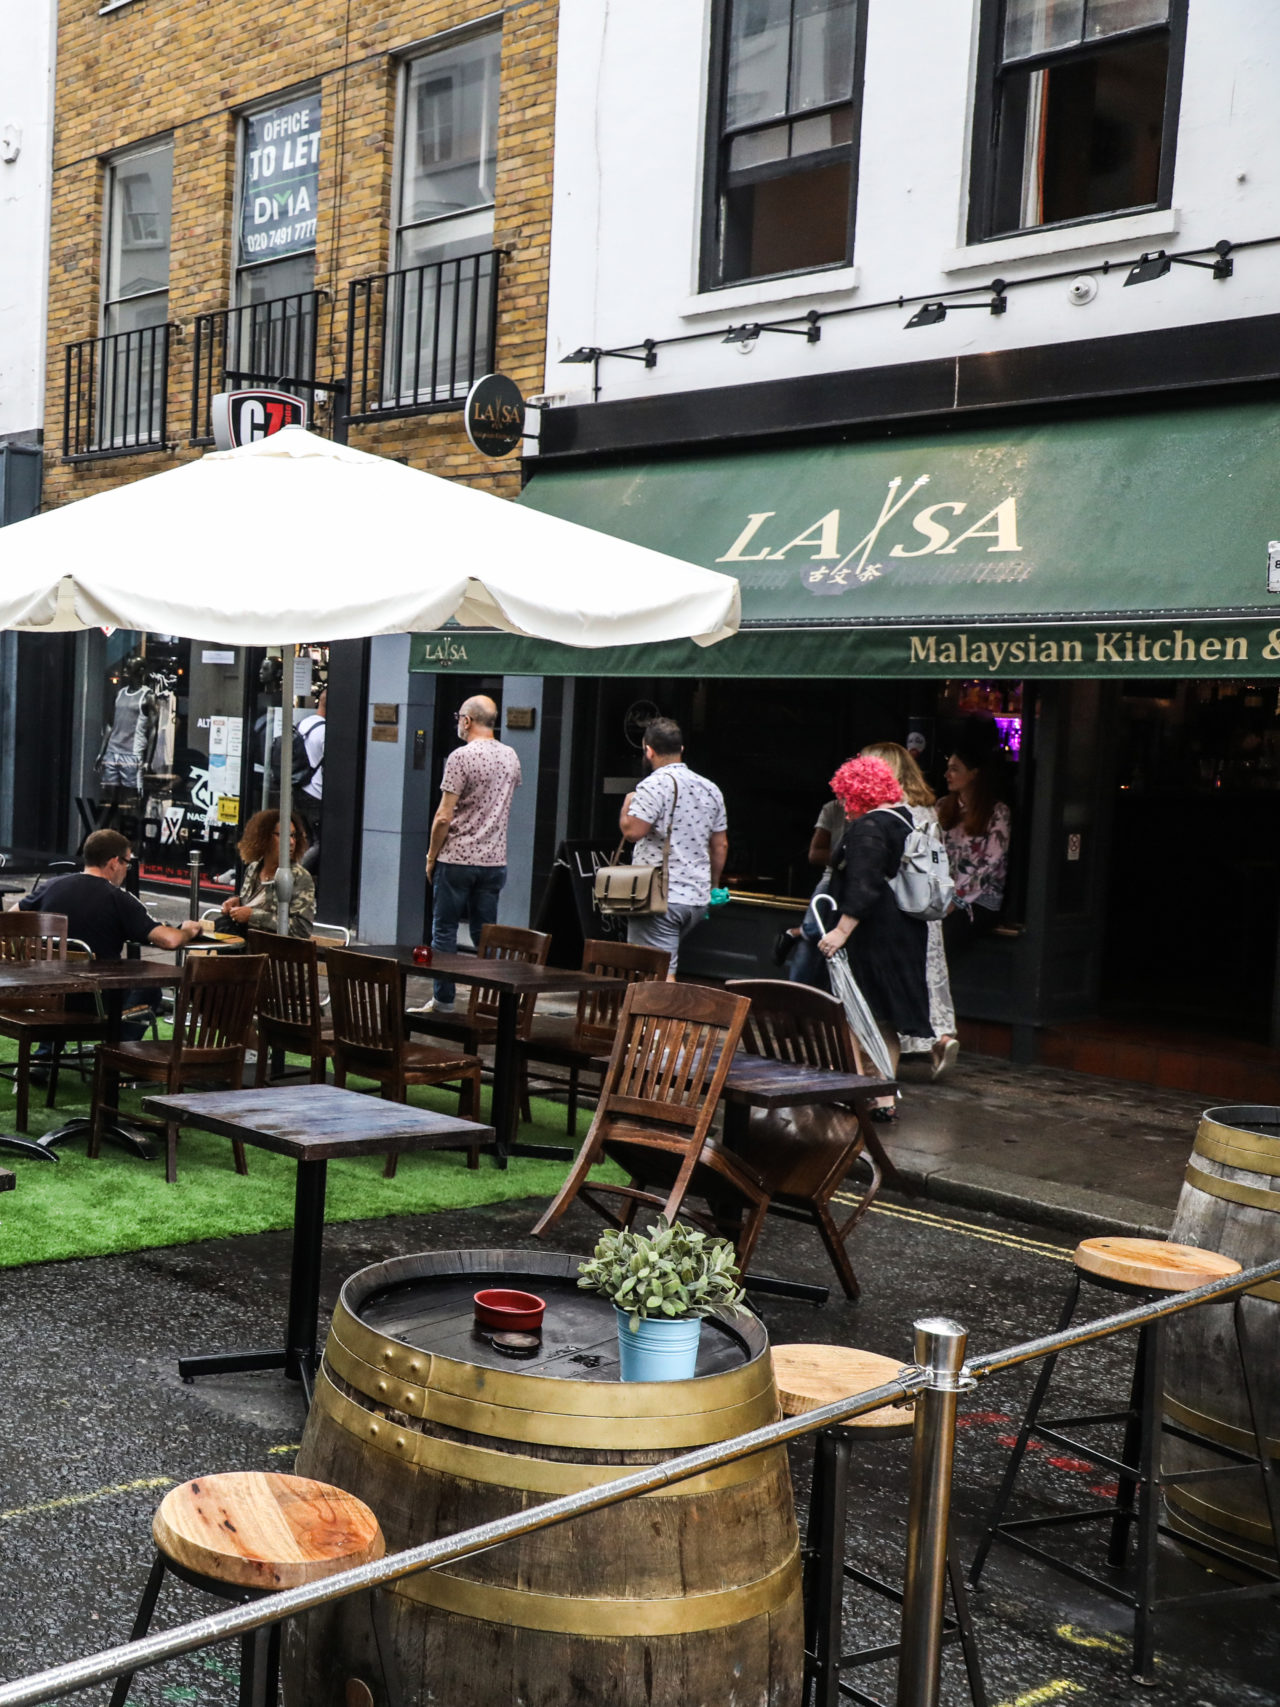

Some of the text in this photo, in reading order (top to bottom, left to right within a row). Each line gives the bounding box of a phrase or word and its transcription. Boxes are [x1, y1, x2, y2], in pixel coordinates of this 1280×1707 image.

[263, 109, 310, 143] OFFICE
[249, 130, 321, 182] TO LET
[253, 185, 311, 225] DMA
[247, 217, 317, 253] 020 7491 7777
[909, 628, 1280, 671] Malaysian Kitchen &
